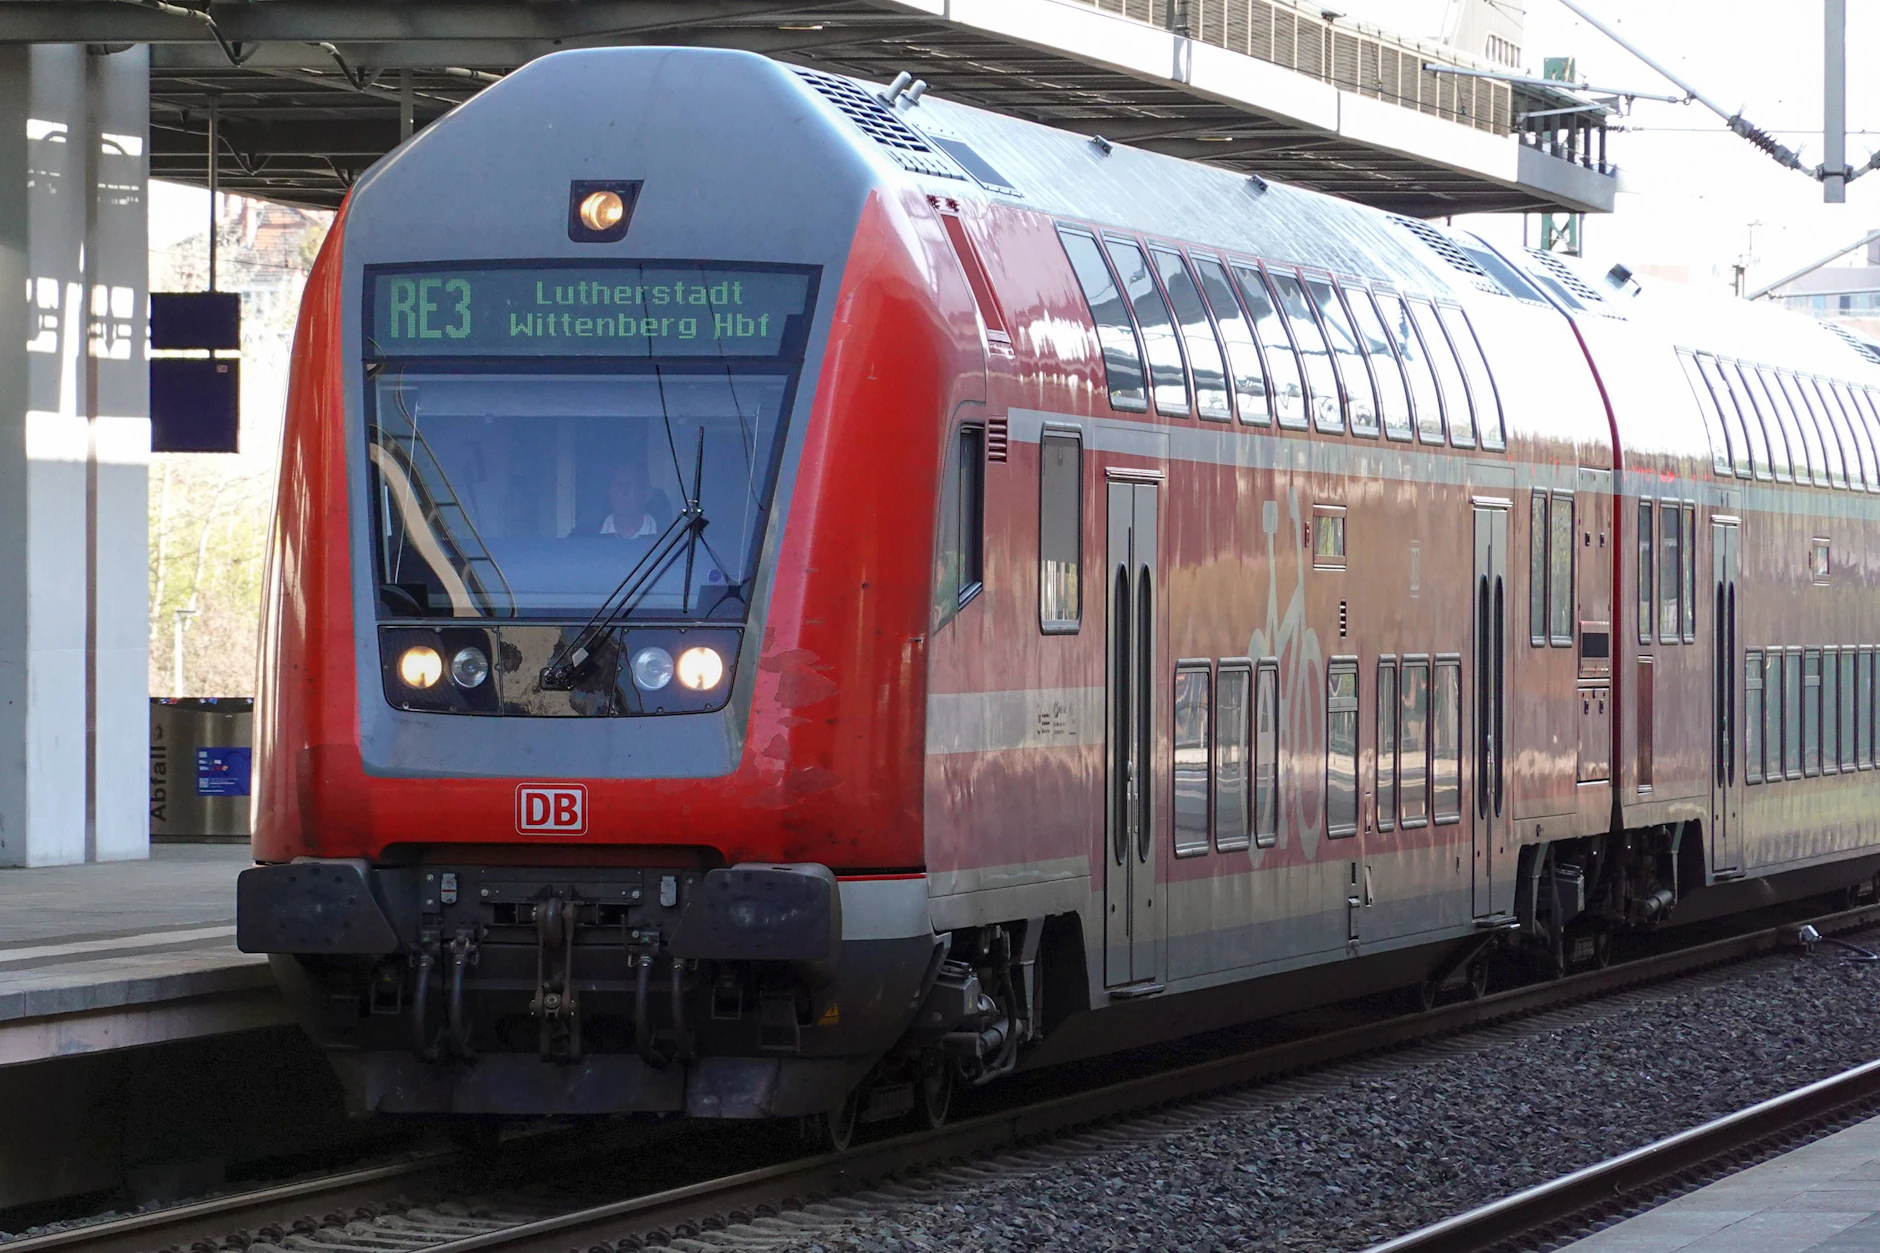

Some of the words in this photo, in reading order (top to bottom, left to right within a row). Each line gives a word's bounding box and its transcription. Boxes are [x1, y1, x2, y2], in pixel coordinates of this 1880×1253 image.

[389, 278, 472, 338] RE3
[535, 281, 744, 305] Lutherstadt
[509, 313, 698, 339] Wittenberg
[714, 312, 770, 338] Hbf
[150, 746, 167, 822] Abfall
[525, 792, 579, 826] DB
